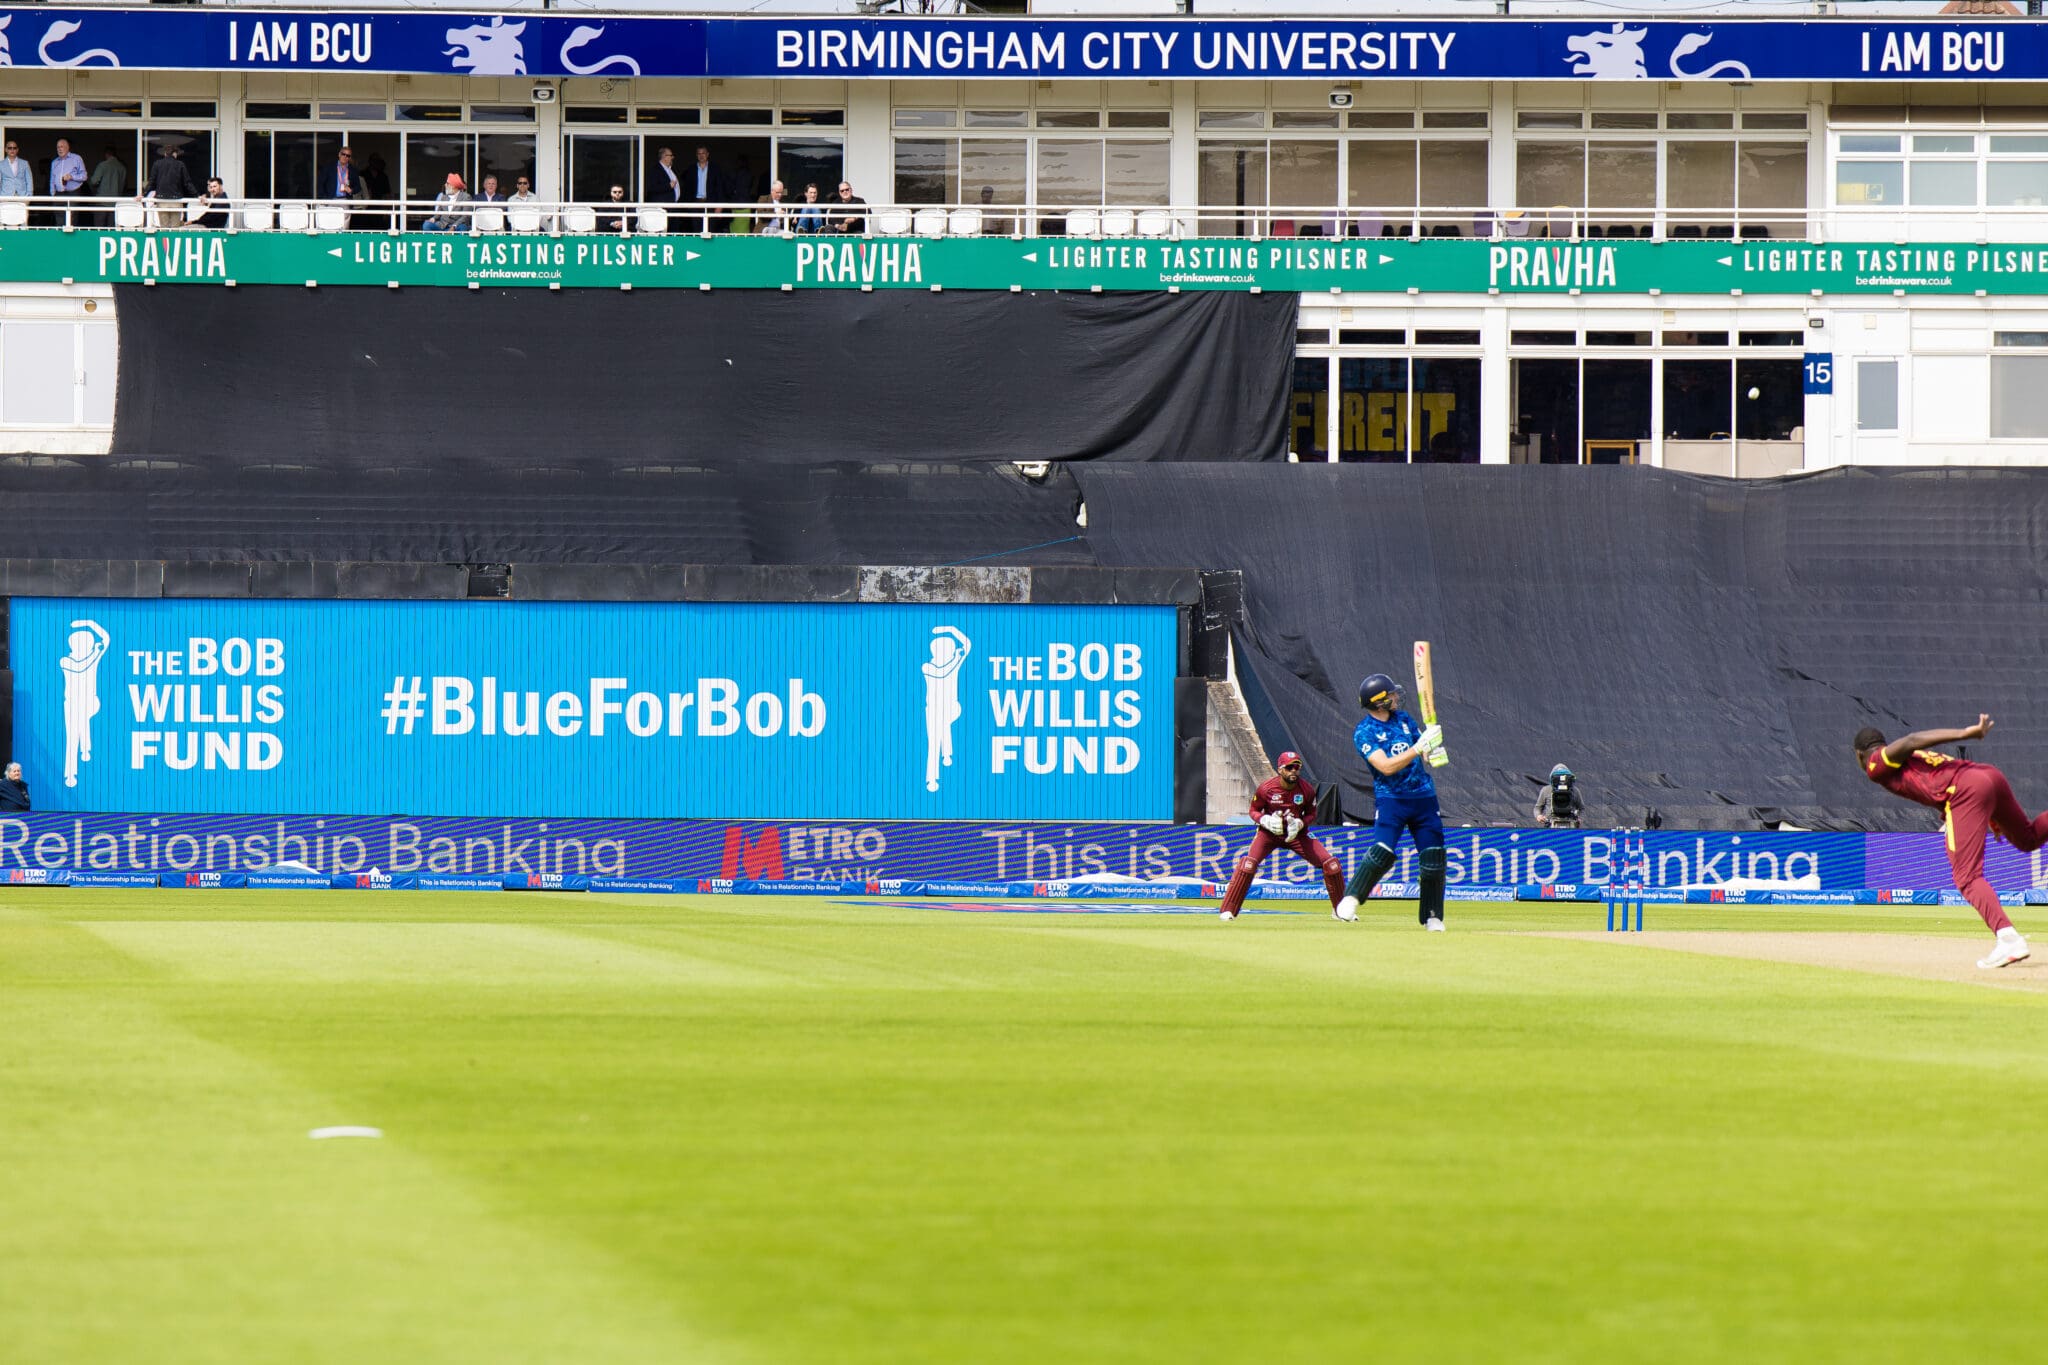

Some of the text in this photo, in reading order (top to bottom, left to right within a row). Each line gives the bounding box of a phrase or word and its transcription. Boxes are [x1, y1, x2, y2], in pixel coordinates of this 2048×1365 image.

[229, 21, 372, 62] I AM BCU
[776, 29, 1456, 72] BIRMINGHAM CITY UNIVERSITY
[1861, 31, 2004, 72] I AM BCU
[99, 236, 226, 277] PRAVHA
[355, 241, 674, 266] LIGHTER TASTING PILSNER
[796, 242, 921, 283] PRAVHA
[1049, 246, 1367, 270] LIGHTER TASTING PILSNER
[1744, 249, 1843, 272] LIGHTER
[1856, 249, 1955, 273] TASTING
[1490, 246, 1616, 287] PRAVHA
[1806, 362, 1831, 384] 15
[128, 637, 285, 677] THE BOB
[988, 642, 1143, 682] THE BOB
[128, 684, 284, 724] WILLIS
[380, 676, 827, 738] #BlueForBob
[989, 689, 1142, 729] WILLIS
[131, 731, 283, 771] FUND
[991, 735, 1141, 775] FUND
[0, 818, 625, 879] Relationship Banking
[982, 828, 1107, 880] This
[1129, 828, 1171, 880] is
[10, 869, 47, 883] METRO
[92, 876, 130, 884] Relationship
[130, 877, 156, 885] Banking
[185, 873, 221, 887] METRO
[356, 875, 392, 889] METRO
[527, 873, 563, 888] METRO
[648, 882, 672, 890] Banking
[697, 879, 733, 894] METRO
[865, 879, 902, 894] METRO
[779, 884, 815, 892] Relationship
[816, 885, 840, 893] Banking
[947, 885, 983, 893] Relationship
[984, 886, 1008, 894] Banking
[1033, 883, 1069, 897] METRO
[1541, 883, 1576, 899] METRO
[1555, 891, 1576, 899] BANK
[1710, 889, 1746, 903] METRO
[1877, 889, 1913, 903] METRO
